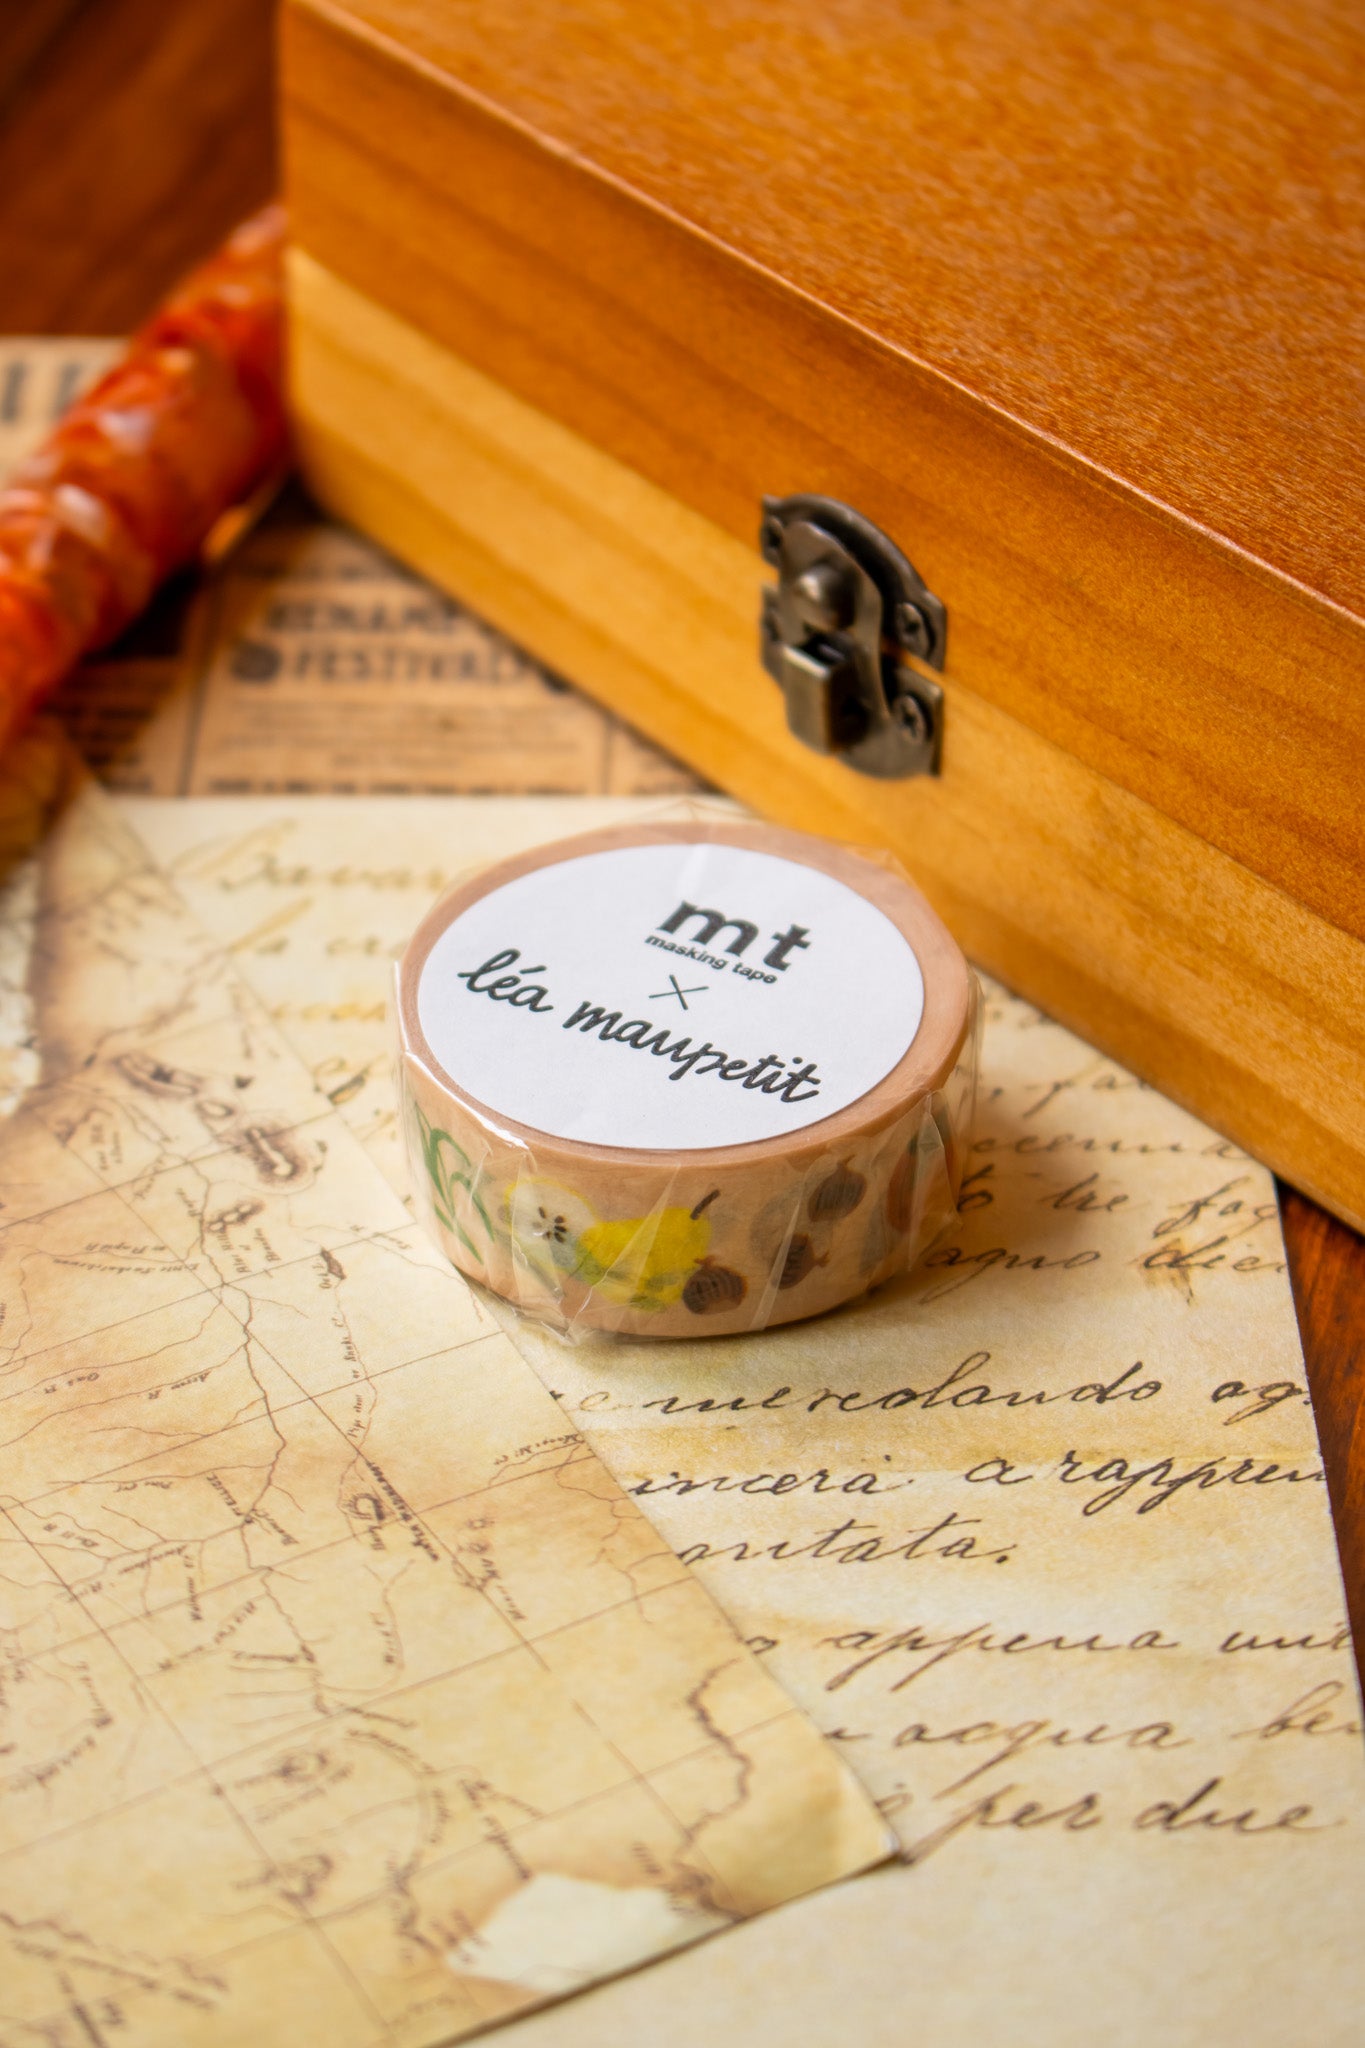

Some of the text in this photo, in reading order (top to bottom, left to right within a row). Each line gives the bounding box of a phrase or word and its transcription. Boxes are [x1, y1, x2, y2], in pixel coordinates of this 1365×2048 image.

[644, 932, 778, 984] masking tape
[657, 899, 812, 972] mt
[457, 948, 820, 1103] léa maupetit
